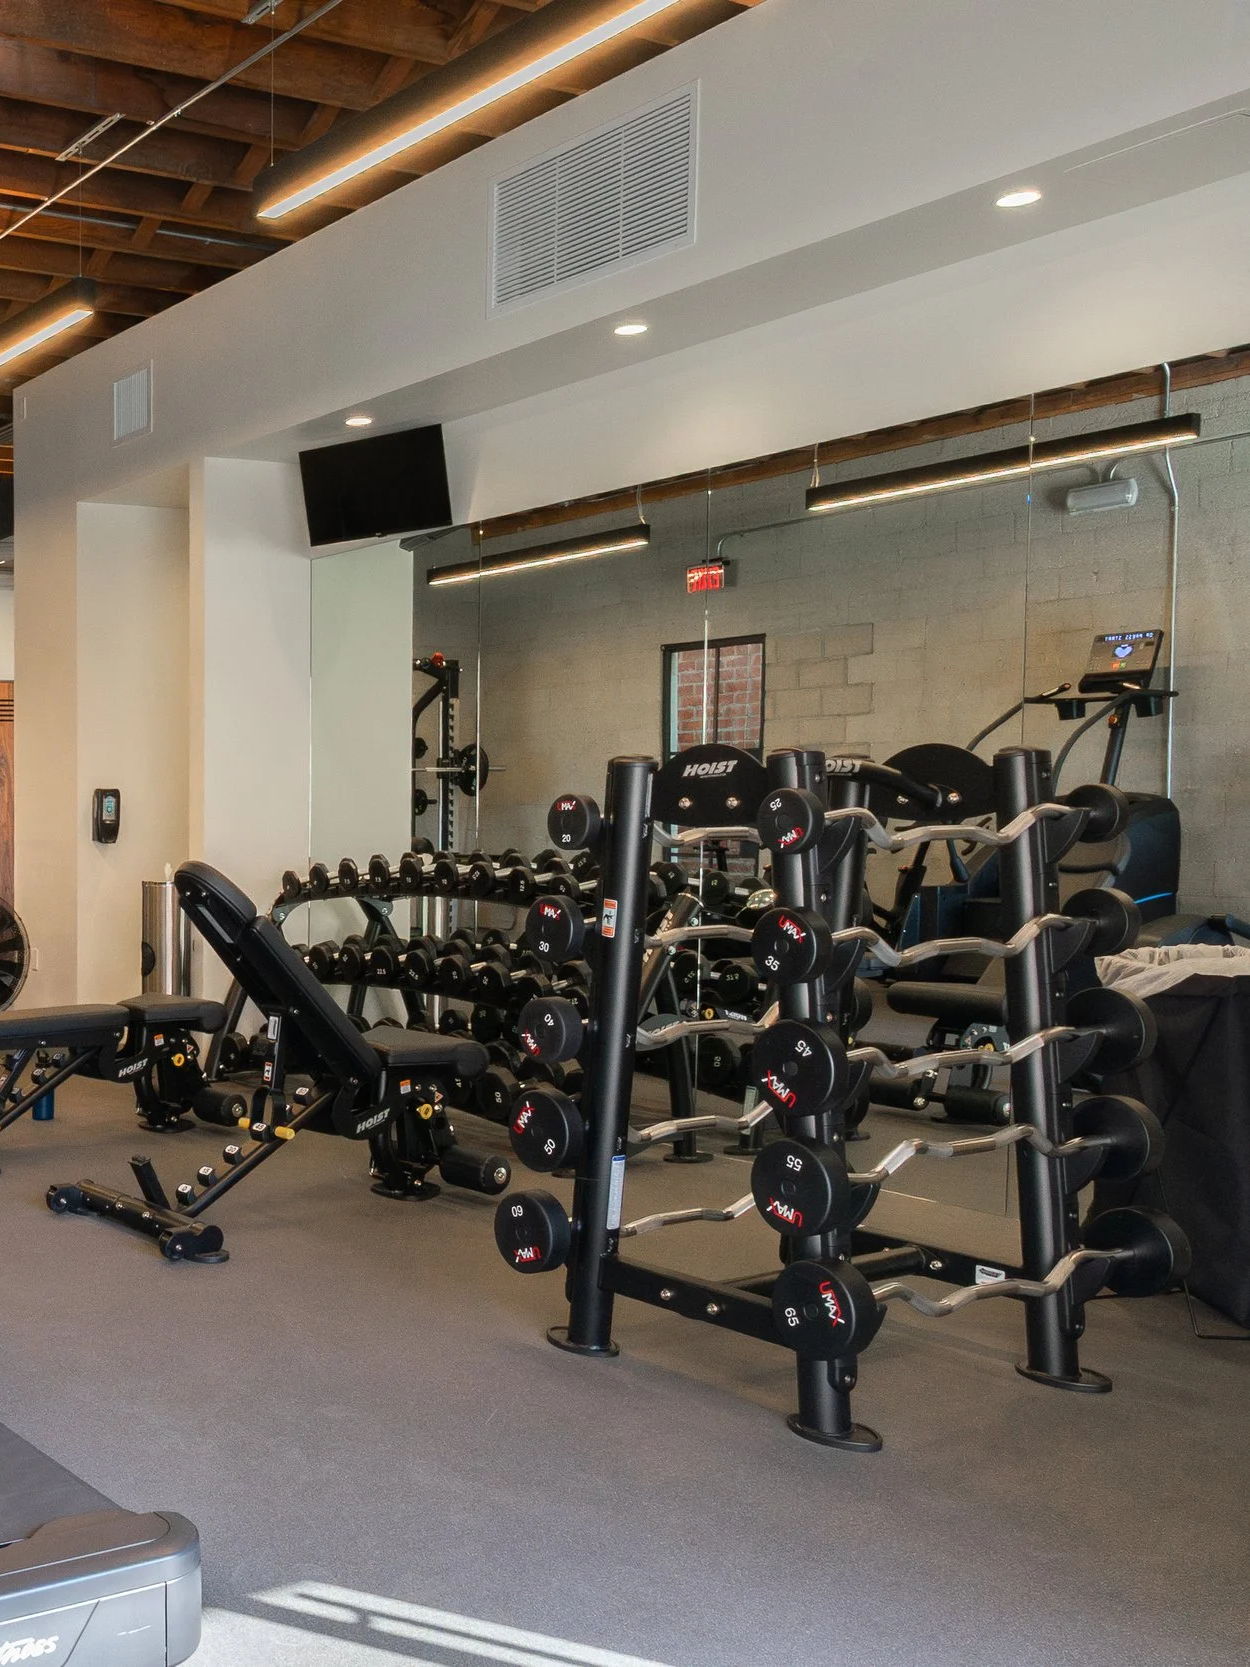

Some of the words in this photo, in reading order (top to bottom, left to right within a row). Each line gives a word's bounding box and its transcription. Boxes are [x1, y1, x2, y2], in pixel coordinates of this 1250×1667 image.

[682, 760, 738, 777] HOIST
[826, 758, 861, 773] OIST
[769, 797, 782, 812] 25
[561, 833, 571, 843] 20
[779, 915, 805, 943] UMAX
[538, 940, 550, 953] 30
[765, 955, 780, 971] 35
[544, 1013, 555, 1026] 40
[795, 1040, 812, 1057] 45
[118, 1058, 149, 1078] HOIST
[761, 1070, 797, 1108] UMAX
[356, 1108, 391, 1134] HOIST
[513, 1101, 535, 1135] UMAX
[543, 1138, 556, 1155] 50
[786, 1154, 803, 1172] 55
[511, 1205, 524, 1218] 60
[765, 1197, 803, 1228] UMAX
[514, 1246, 541, 1263] UMAX
[819, 1280, 845, 1327] UMAX
[784, 1307, 800, 1327] 65
